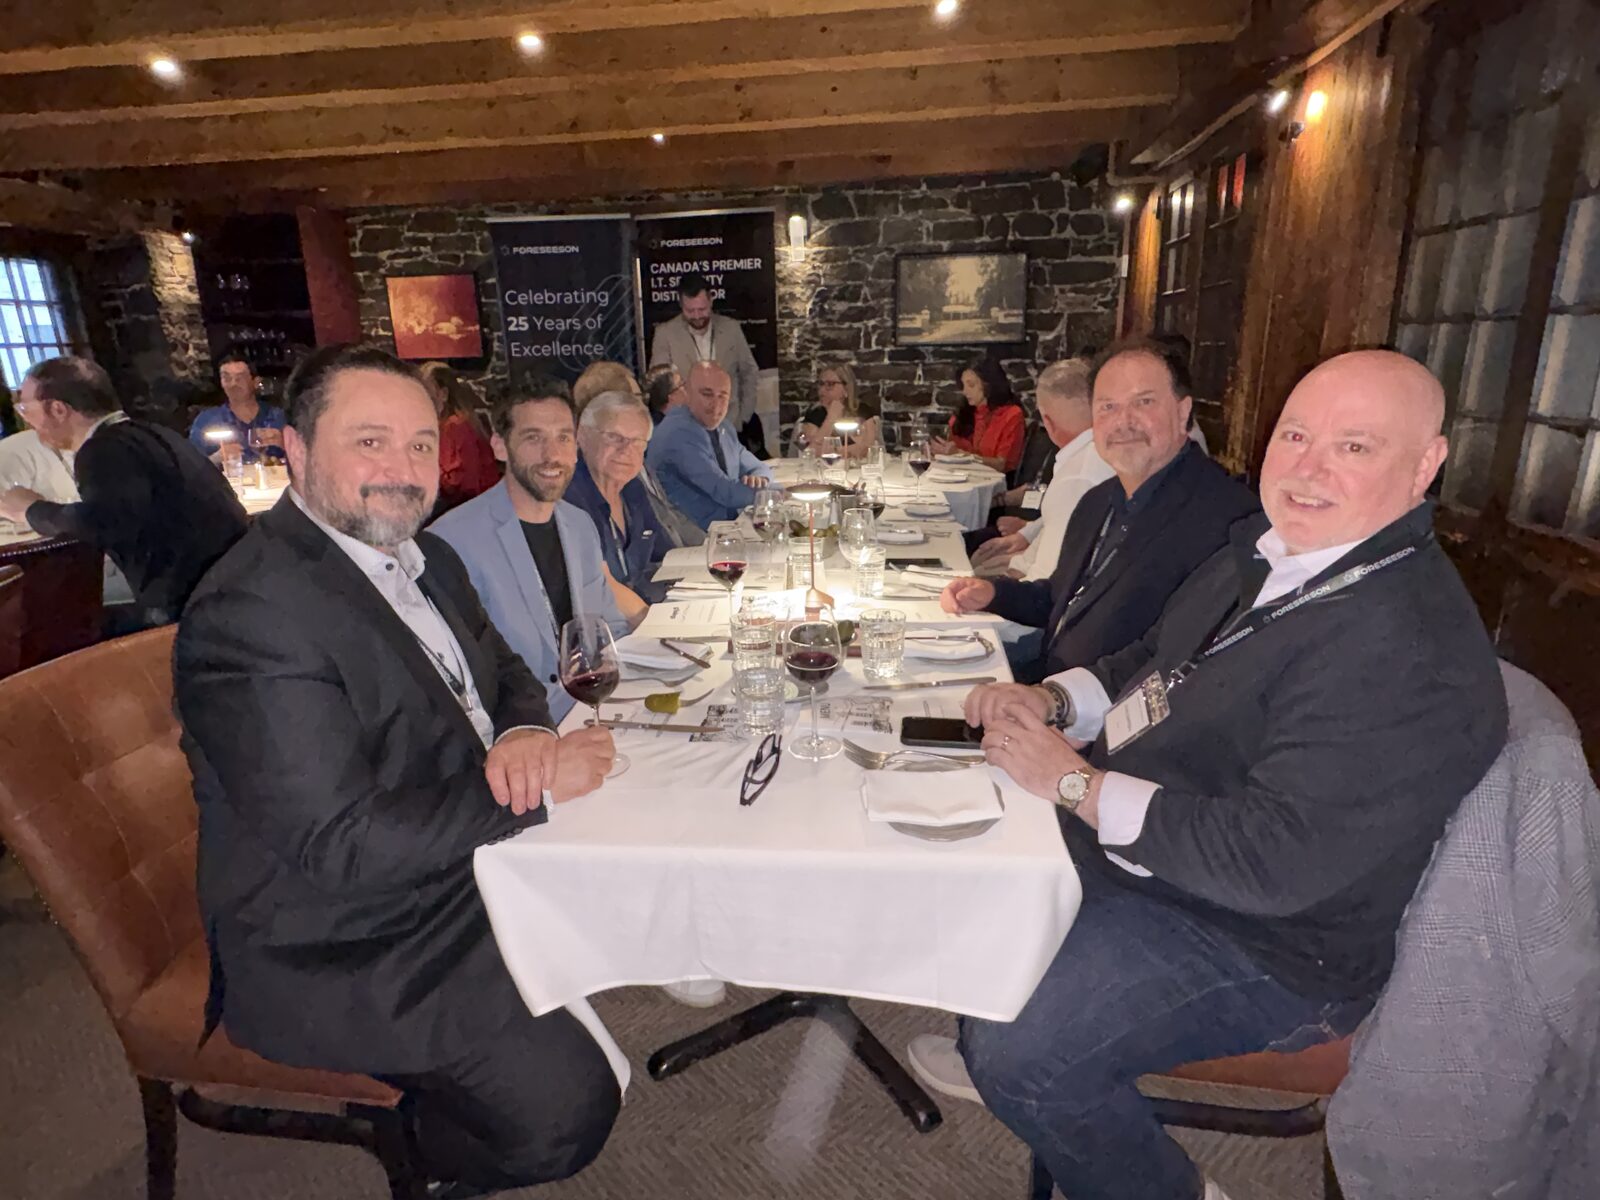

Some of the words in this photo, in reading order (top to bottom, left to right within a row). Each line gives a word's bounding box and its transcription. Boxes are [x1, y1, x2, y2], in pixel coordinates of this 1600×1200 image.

[512, 245, 579, 255] FORESEESON
[660, 237, 723, 248] FORESEESON
[650, 260, 710, 274] CANADA'S
[712, 257, 762, 271] PREMIER
[505, 288, 609, 307] Celebrating
[652, 288, 726, 302] DISTOR
[506, 316, 529, 331] 25
[532, 315, 581, 331] Years
[585, 313, 603, 330] of
[511, 340, 604, 357] Excellence
[1354, 545, 1416, 578] FORESEESON
[1271, 584, 1331, 620] FORESEESON
